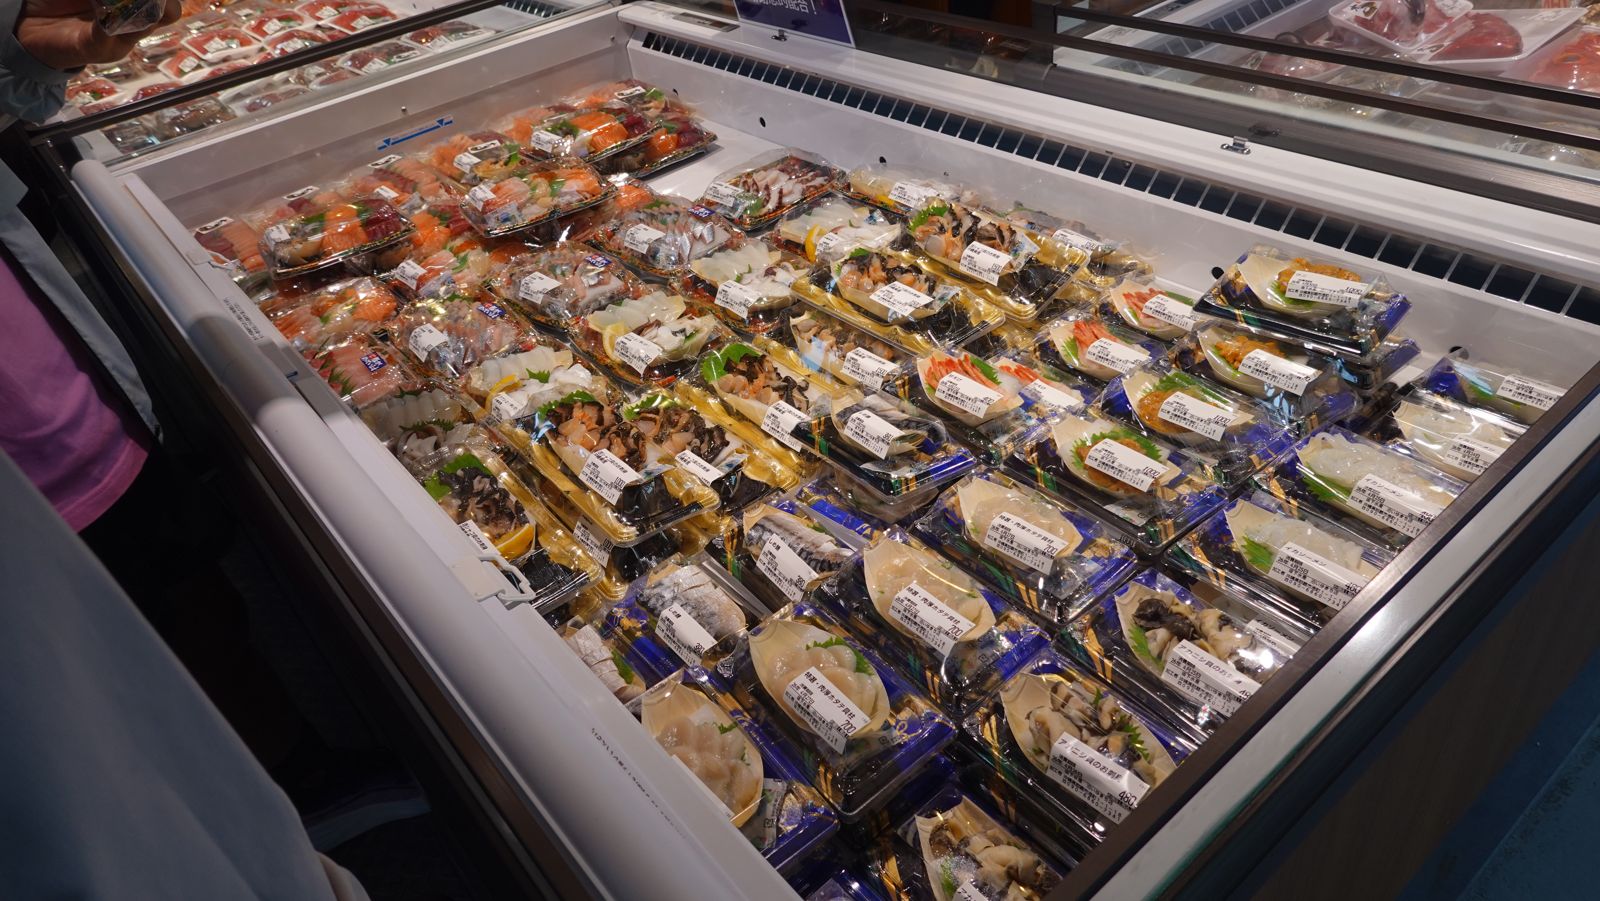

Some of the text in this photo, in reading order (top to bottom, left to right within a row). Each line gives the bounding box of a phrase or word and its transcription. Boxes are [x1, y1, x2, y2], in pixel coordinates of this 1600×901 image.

[948, 624, 964, 638] 700
[1178, 644, 1242, 684] アカニシ貝のお
[841, 720, 857, 734] 700
[1058, 738, 1122, 782] アニシ貝のお刺
[1118, 790, 1137, 807] 480
